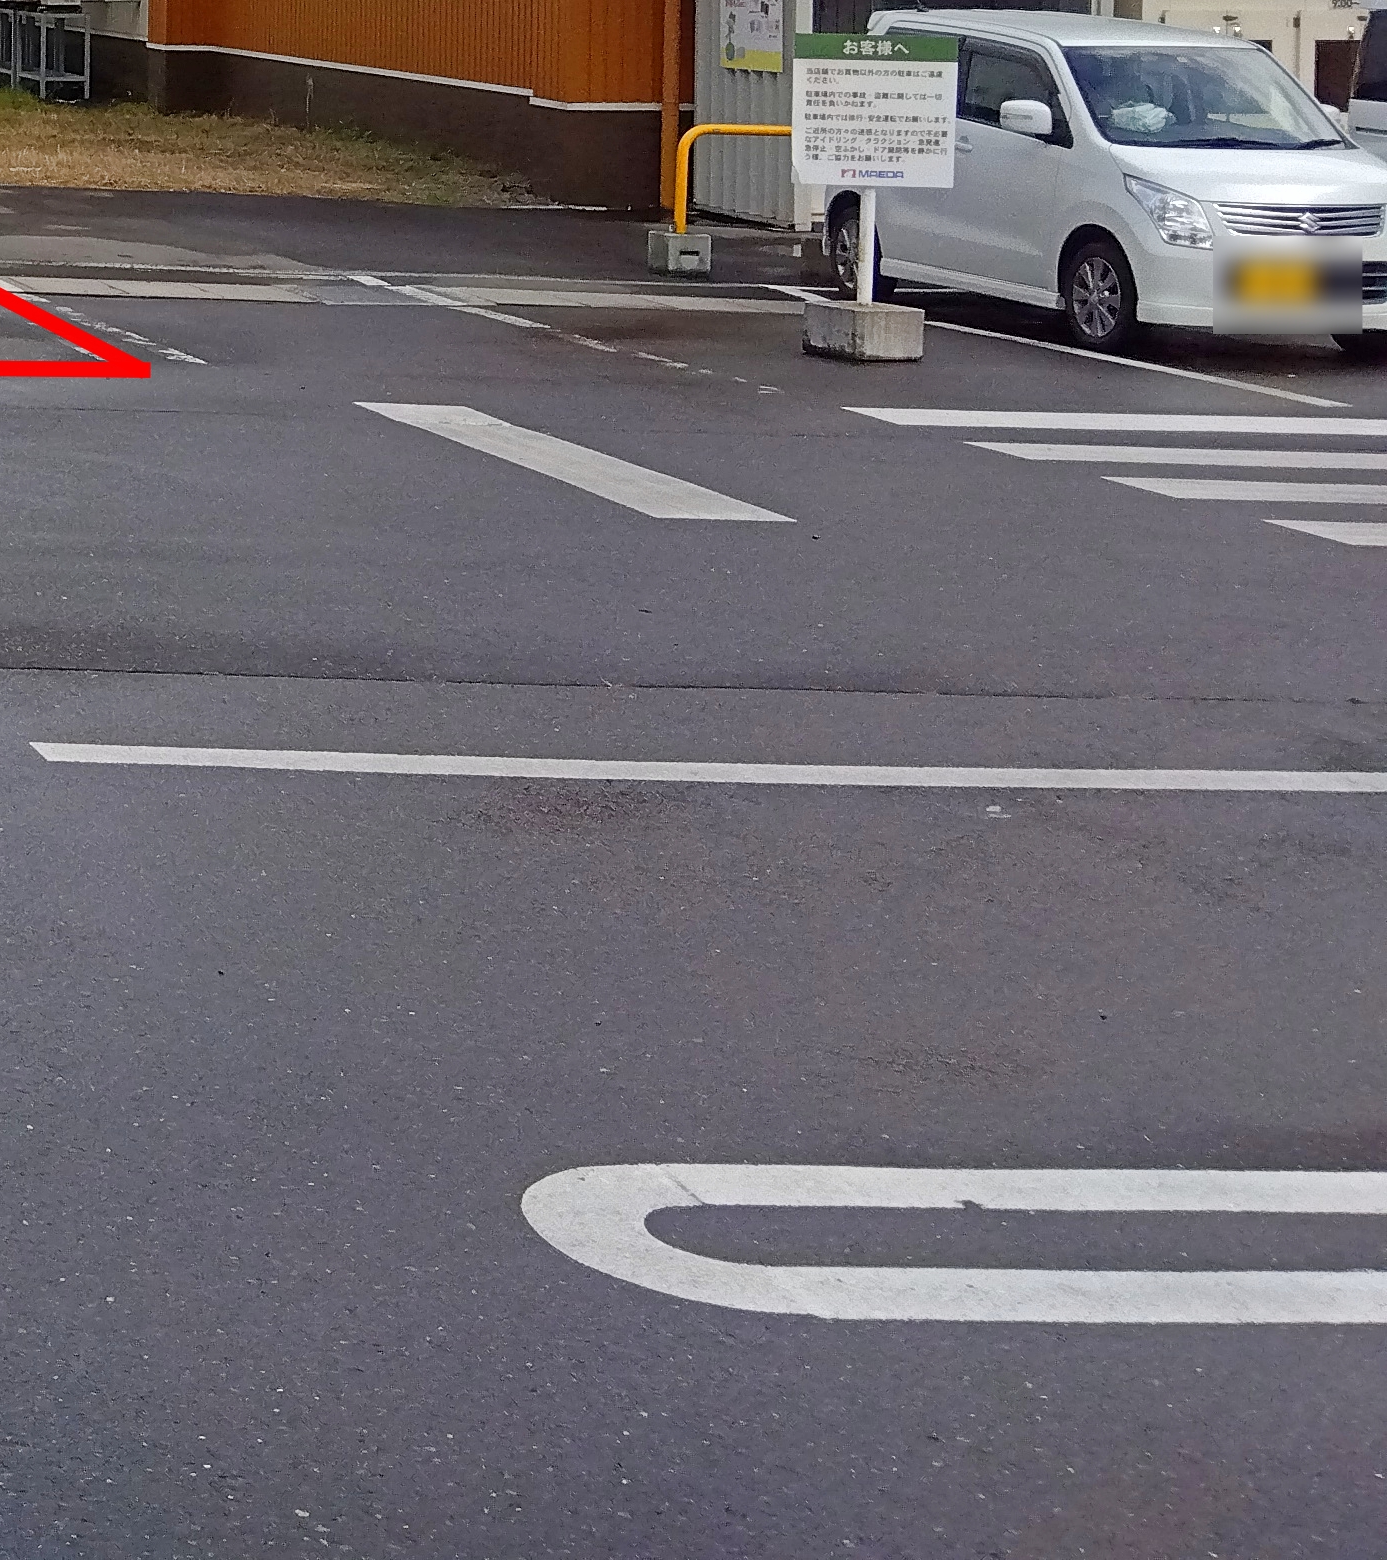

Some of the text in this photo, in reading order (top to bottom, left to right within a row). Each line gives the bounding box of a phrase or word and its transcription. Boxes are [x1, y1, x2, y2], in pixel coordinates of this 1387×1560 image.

[842, 39, 910, 56] お客様へ
[858, 169, 905, 179] MAEDA
